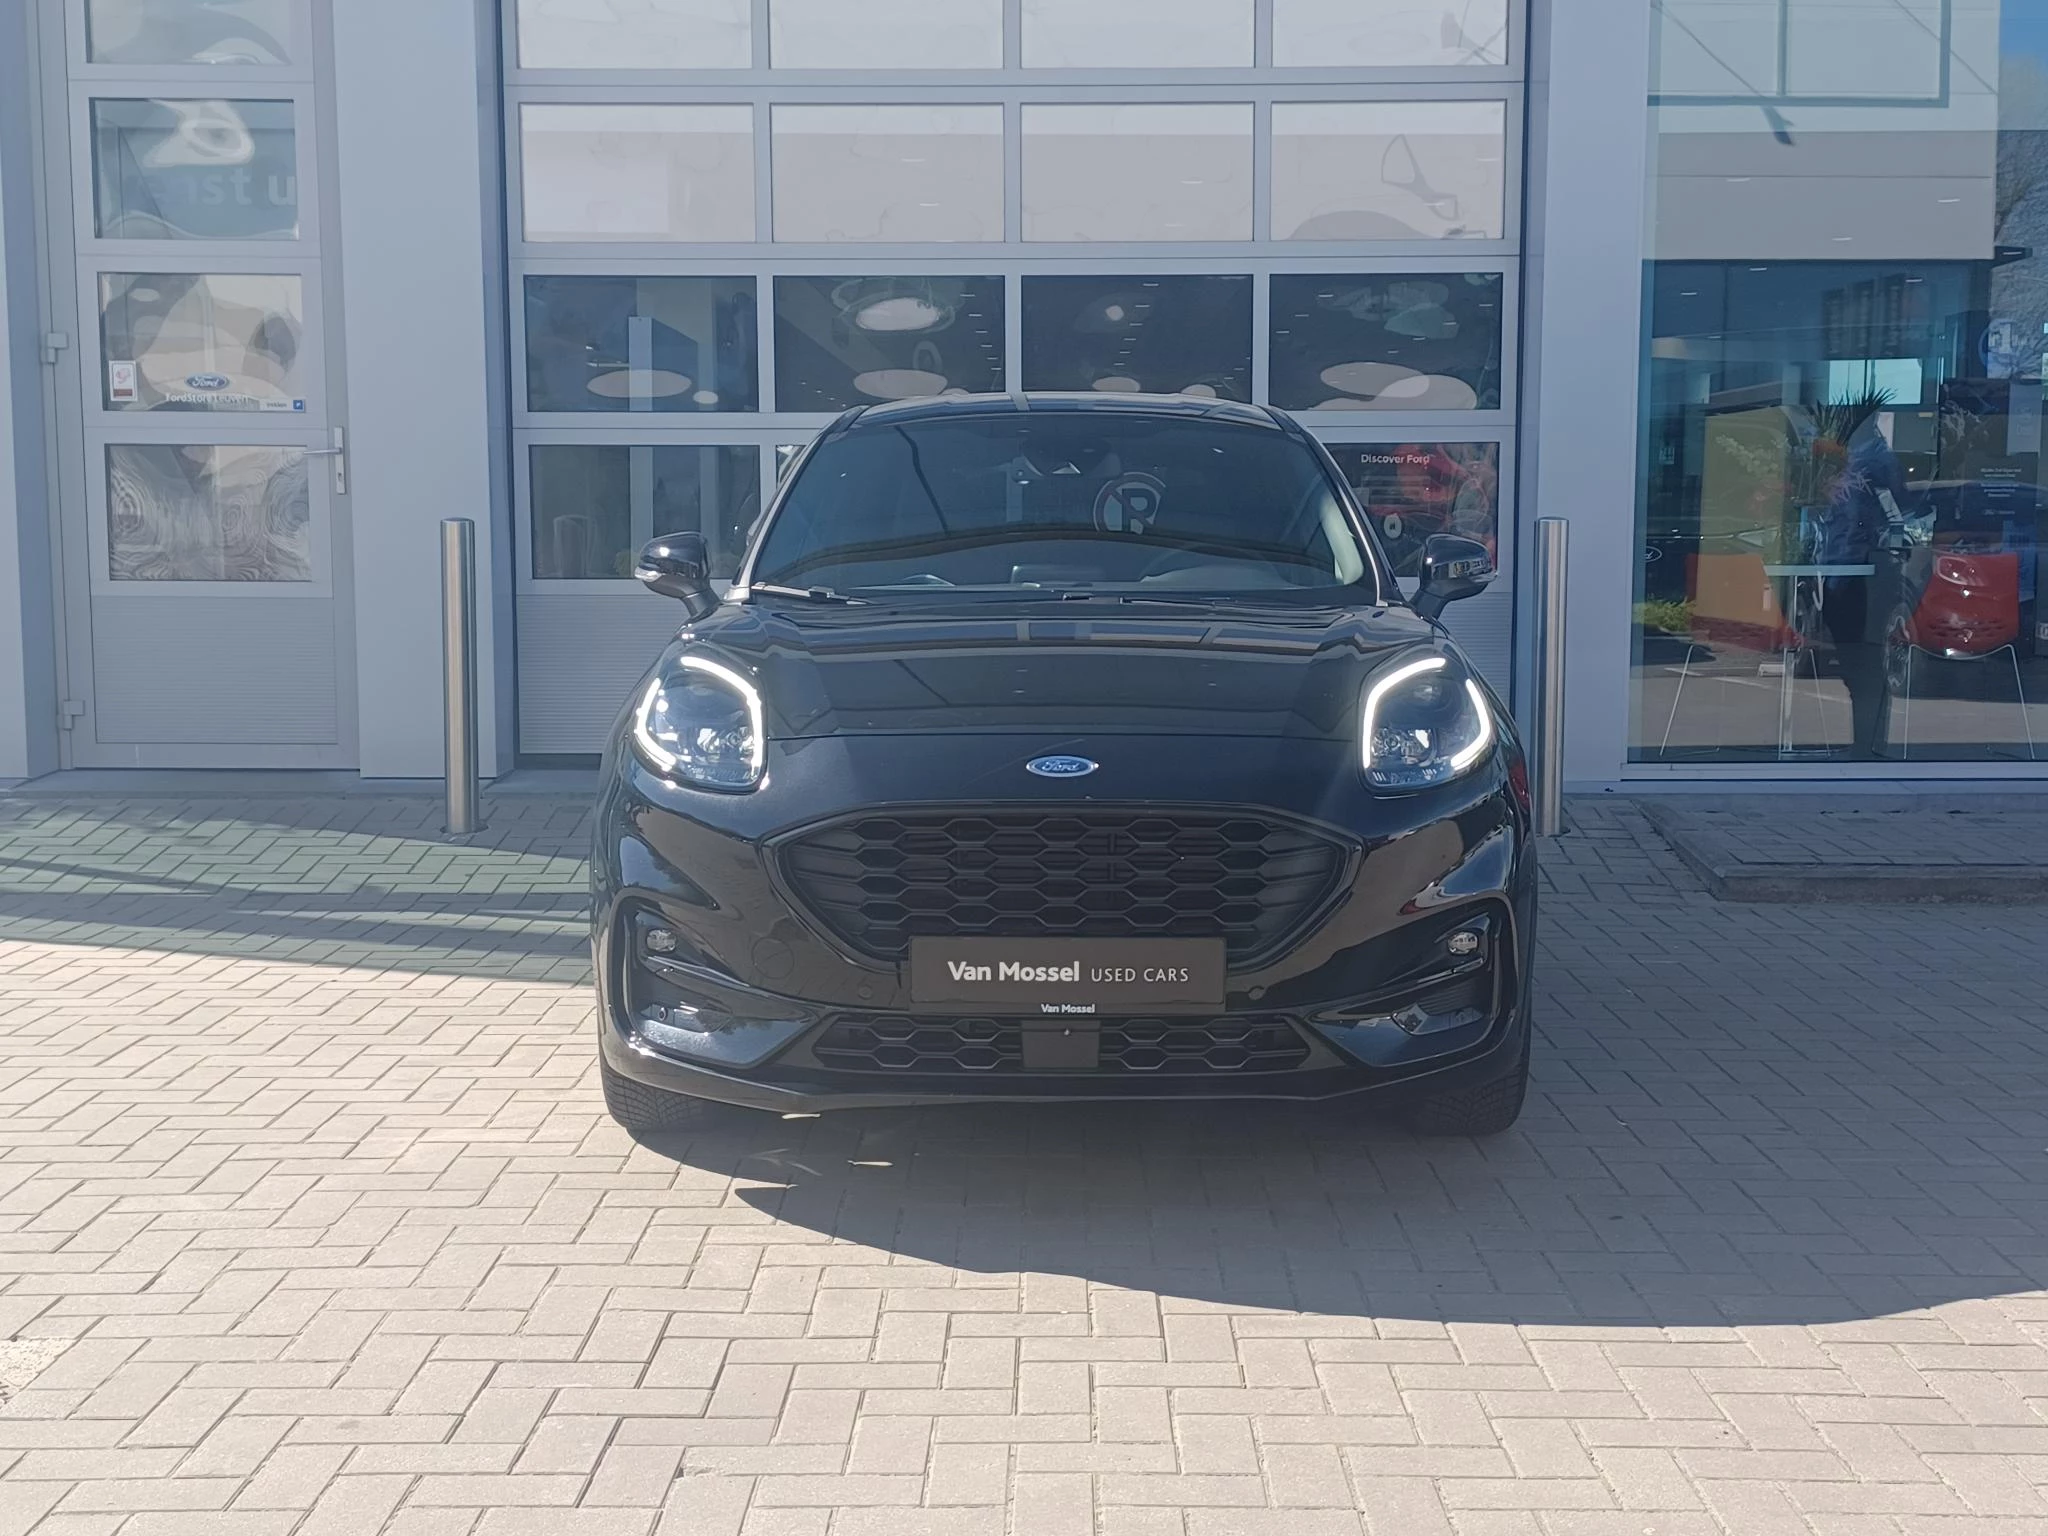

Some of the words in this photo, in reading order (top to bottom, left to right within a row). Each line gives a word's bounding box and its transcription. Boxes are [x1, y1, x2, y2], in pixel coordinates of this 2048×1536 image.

[1360, 454, 1404, 464] Discover
[1406, 454, 1430, 464] Ford
[947, 961, 992, 982] Van
[998, 961, 1080, 982] Mossel
[1091, 967, 1137, 982] USED
[1143, 967, 1189, 982] CARS
[1041, 1003, 1060, 1013] Van
[1061, 1003, 1096, 1014] Mossel
